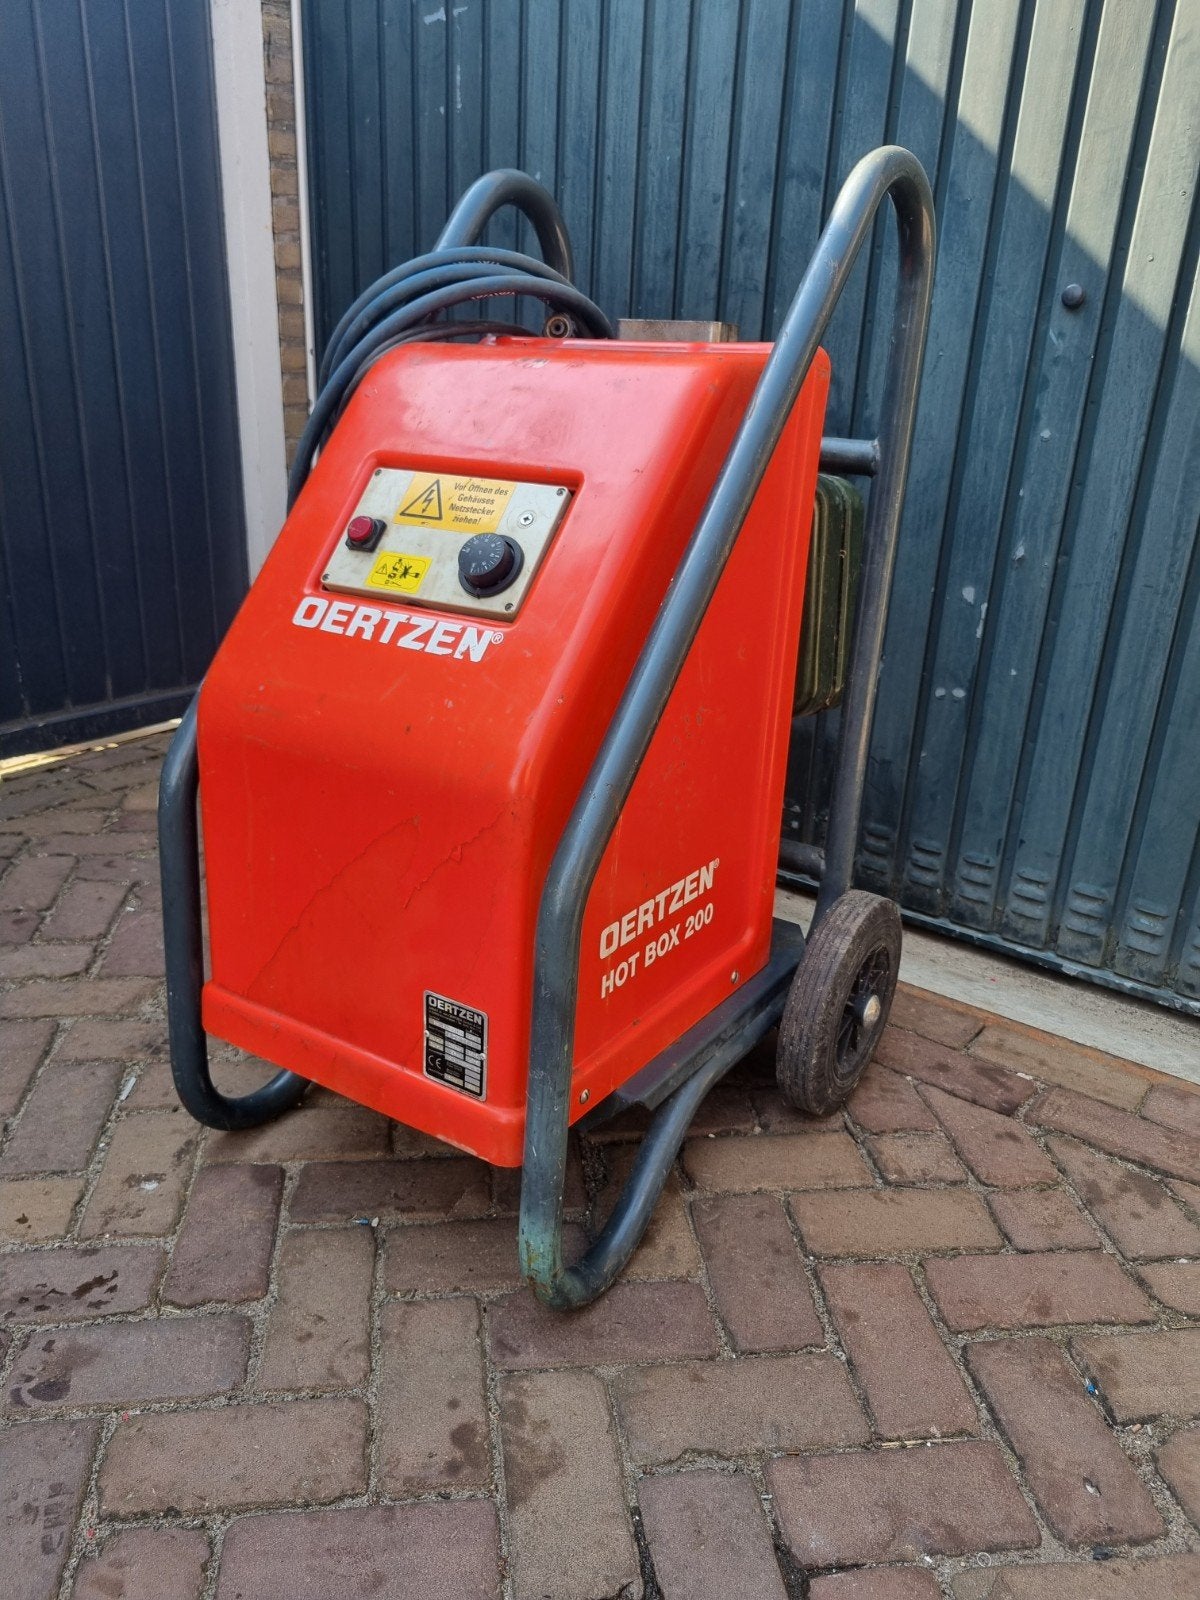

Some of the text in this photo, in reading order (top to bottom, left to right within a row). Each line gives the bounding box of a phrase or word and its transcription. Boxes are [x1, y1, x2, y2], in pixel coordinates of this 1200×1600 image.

[494, 487, 510, 496] des
[457, 493, 495, 505] Gehäuses
[449, 503, 495, 516] Netzstecker
[601, 902, 714, 999] HOT BOX 200
[428, 996, 482, 1026] OERTZEN
